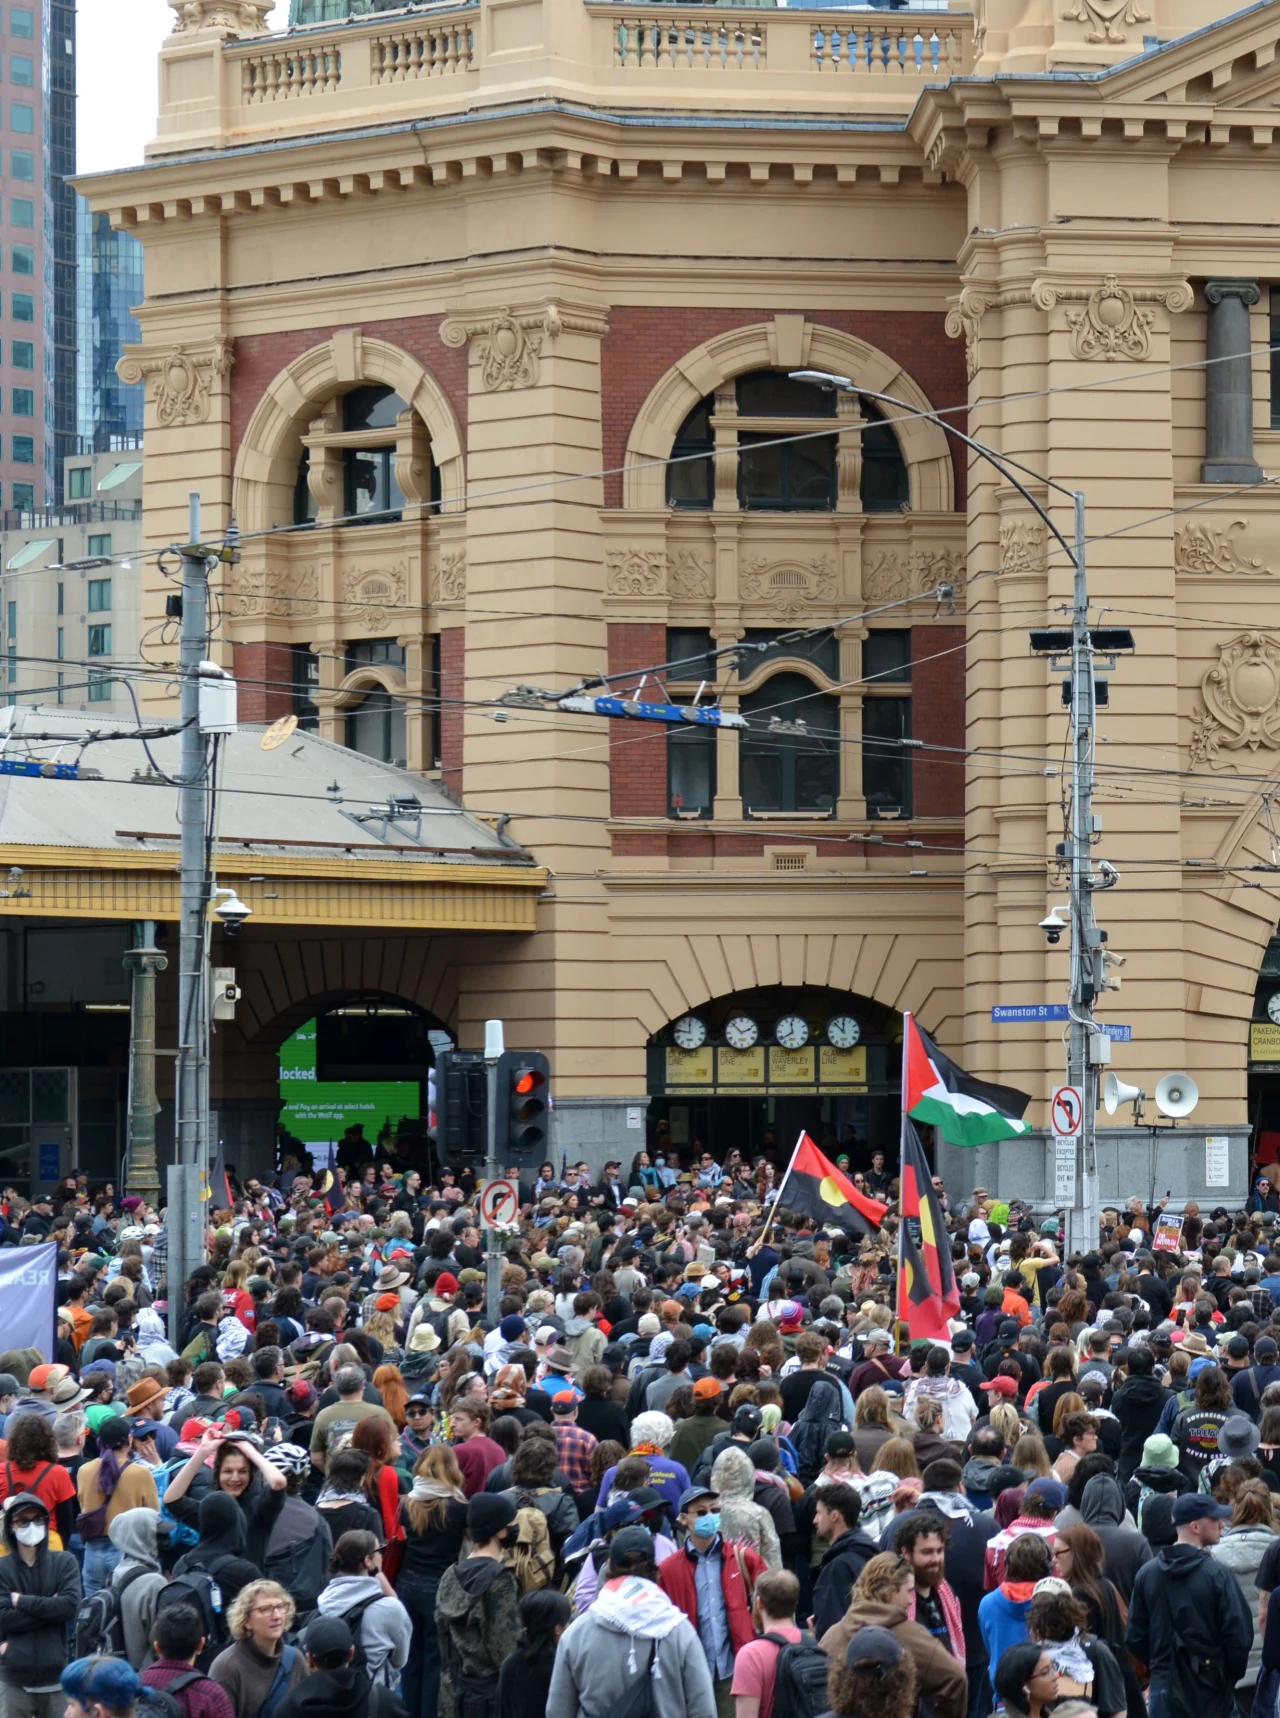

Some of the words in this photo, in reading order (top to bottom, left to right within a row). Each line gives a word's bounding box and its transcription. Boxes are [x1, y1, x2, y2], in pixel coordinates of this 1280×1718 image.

[994, 1007, 1037, 1017] Swanston
[1038, 1006, 1048, 1016] St
[1103, 1025, 1122, 1036] Flinders
[1186, 1412, 1228, 1423] SOVEREIGN
[1186, 1448, 1208, 1459] NEVER
